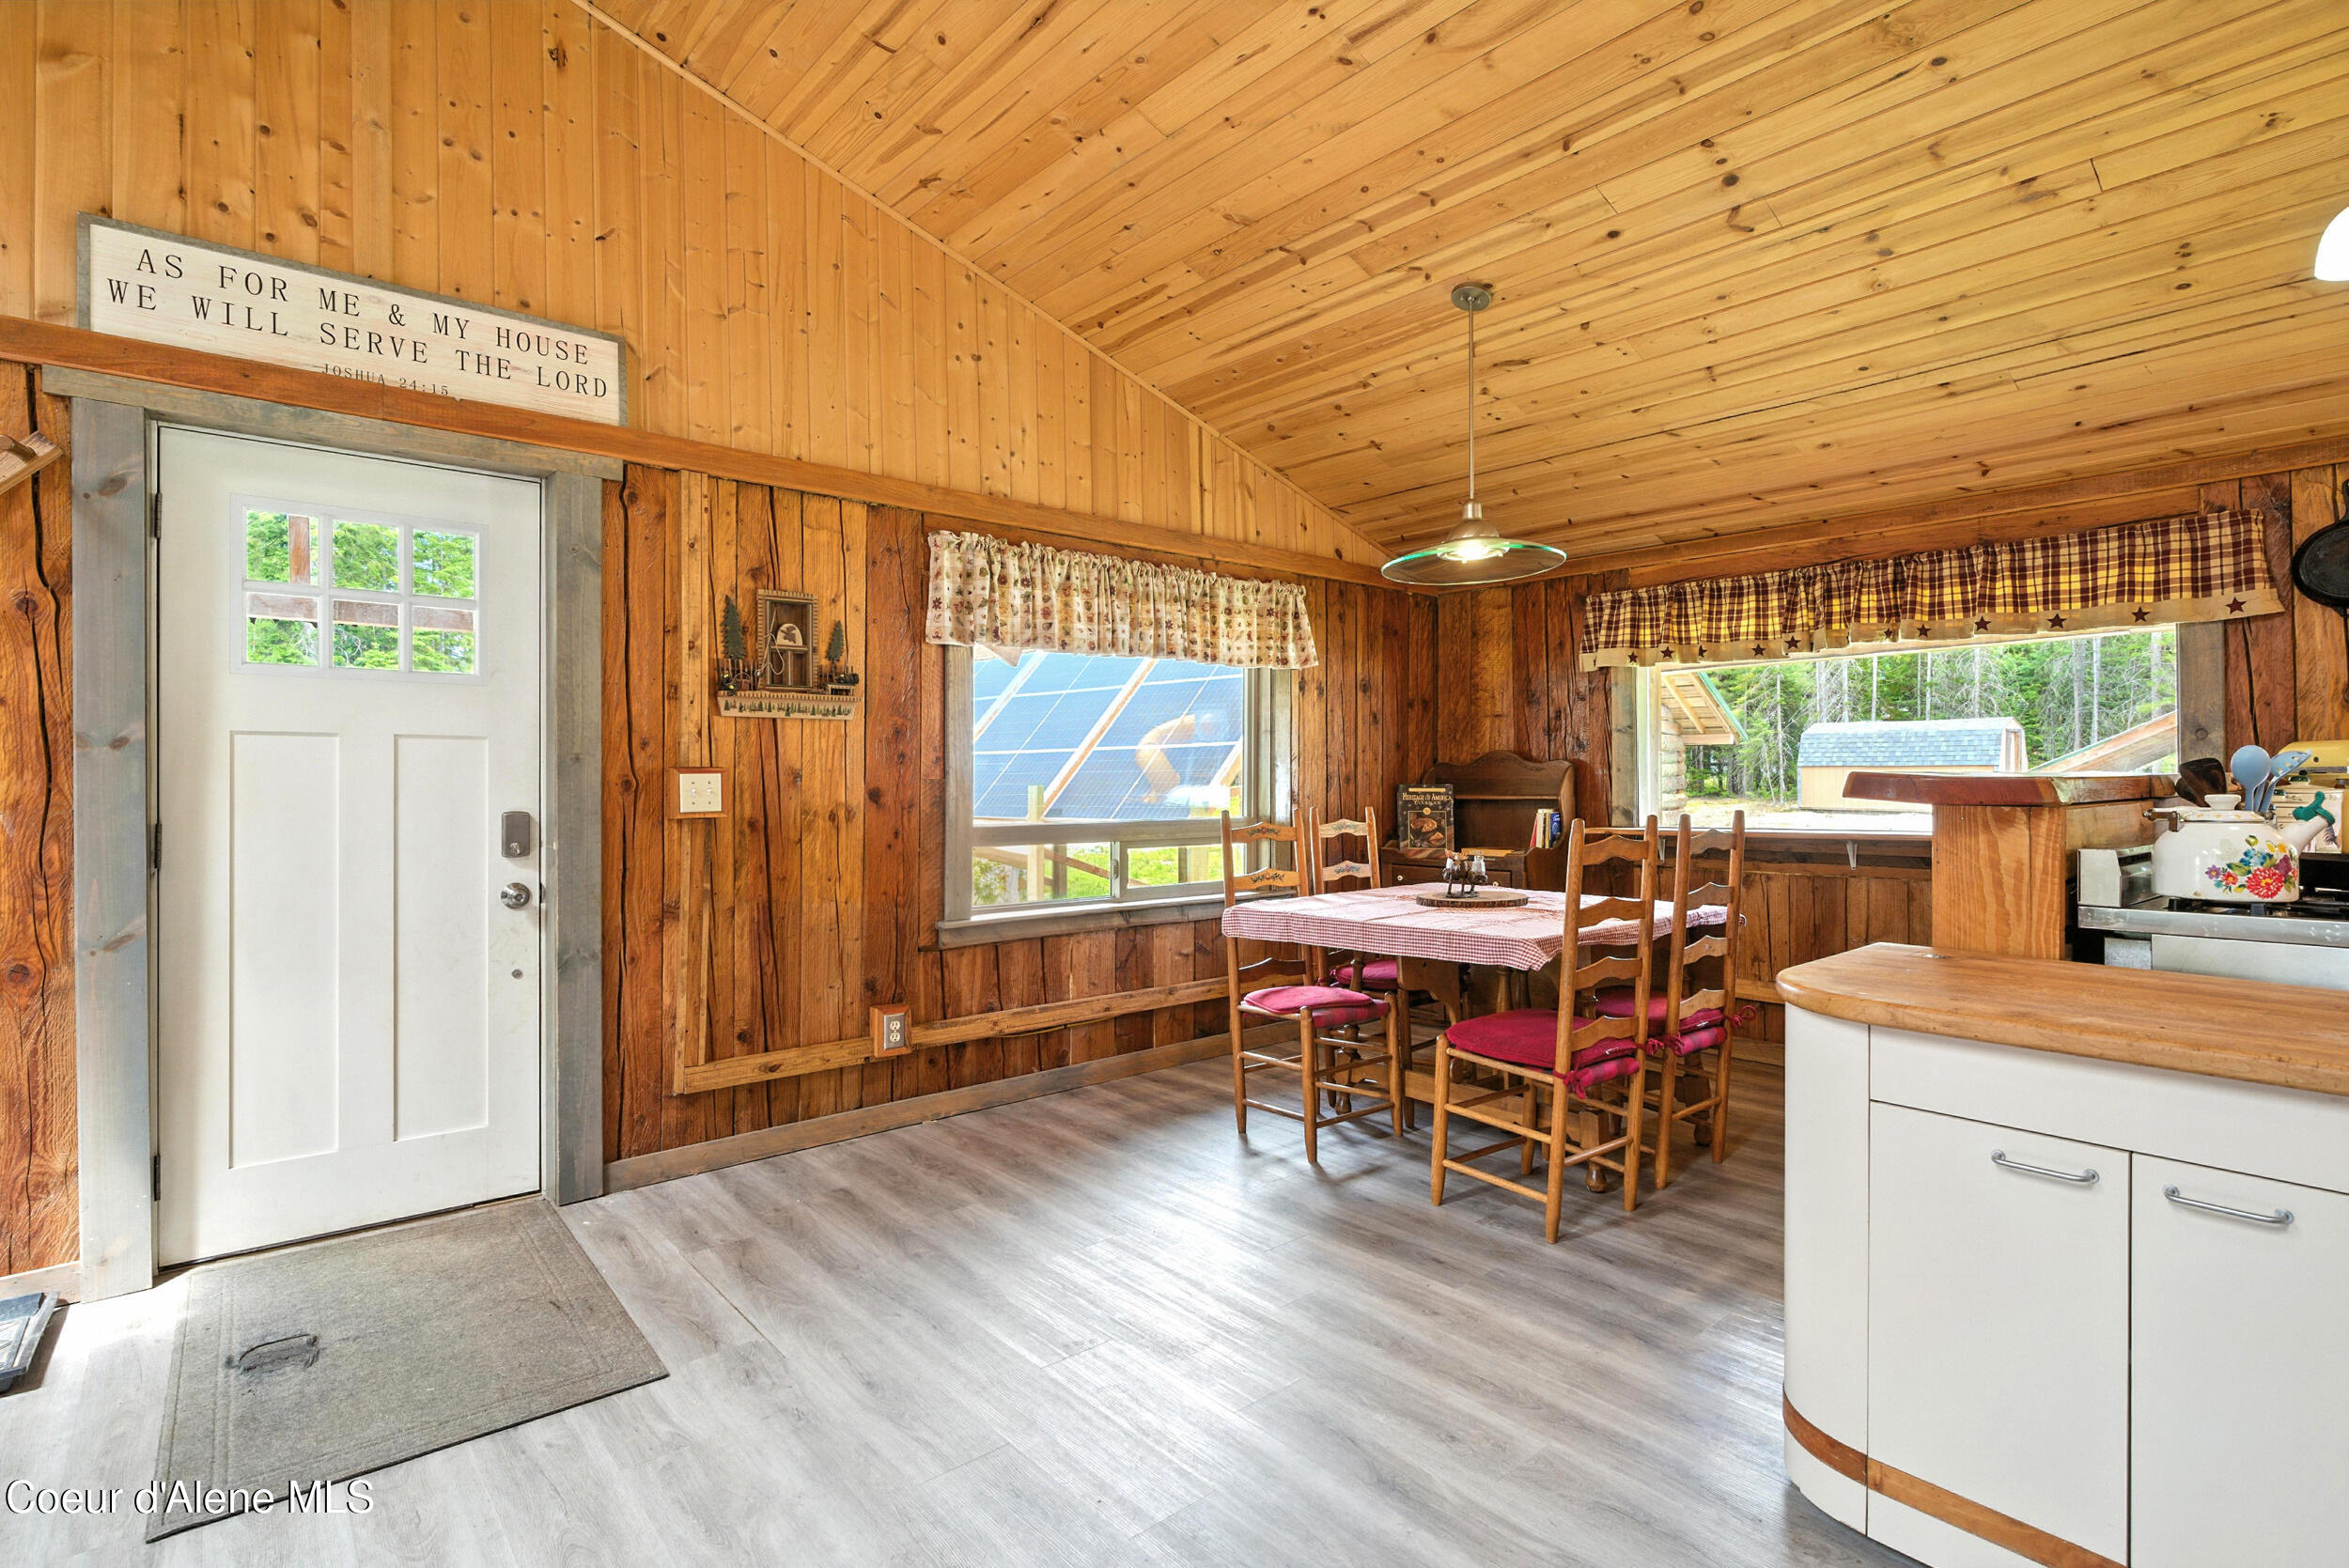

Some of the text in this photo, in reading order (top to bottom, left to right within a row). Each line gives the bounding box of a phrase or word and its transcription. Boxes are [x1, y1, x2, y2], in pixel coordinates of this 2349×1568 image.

[107, 278, 607, 397] WE WILL SERVE THE LORD
[136, 249, 588, 365] AS FOR ME & MY HOUSE
[321, 364, 448, 396] JOSHUA 24:15
